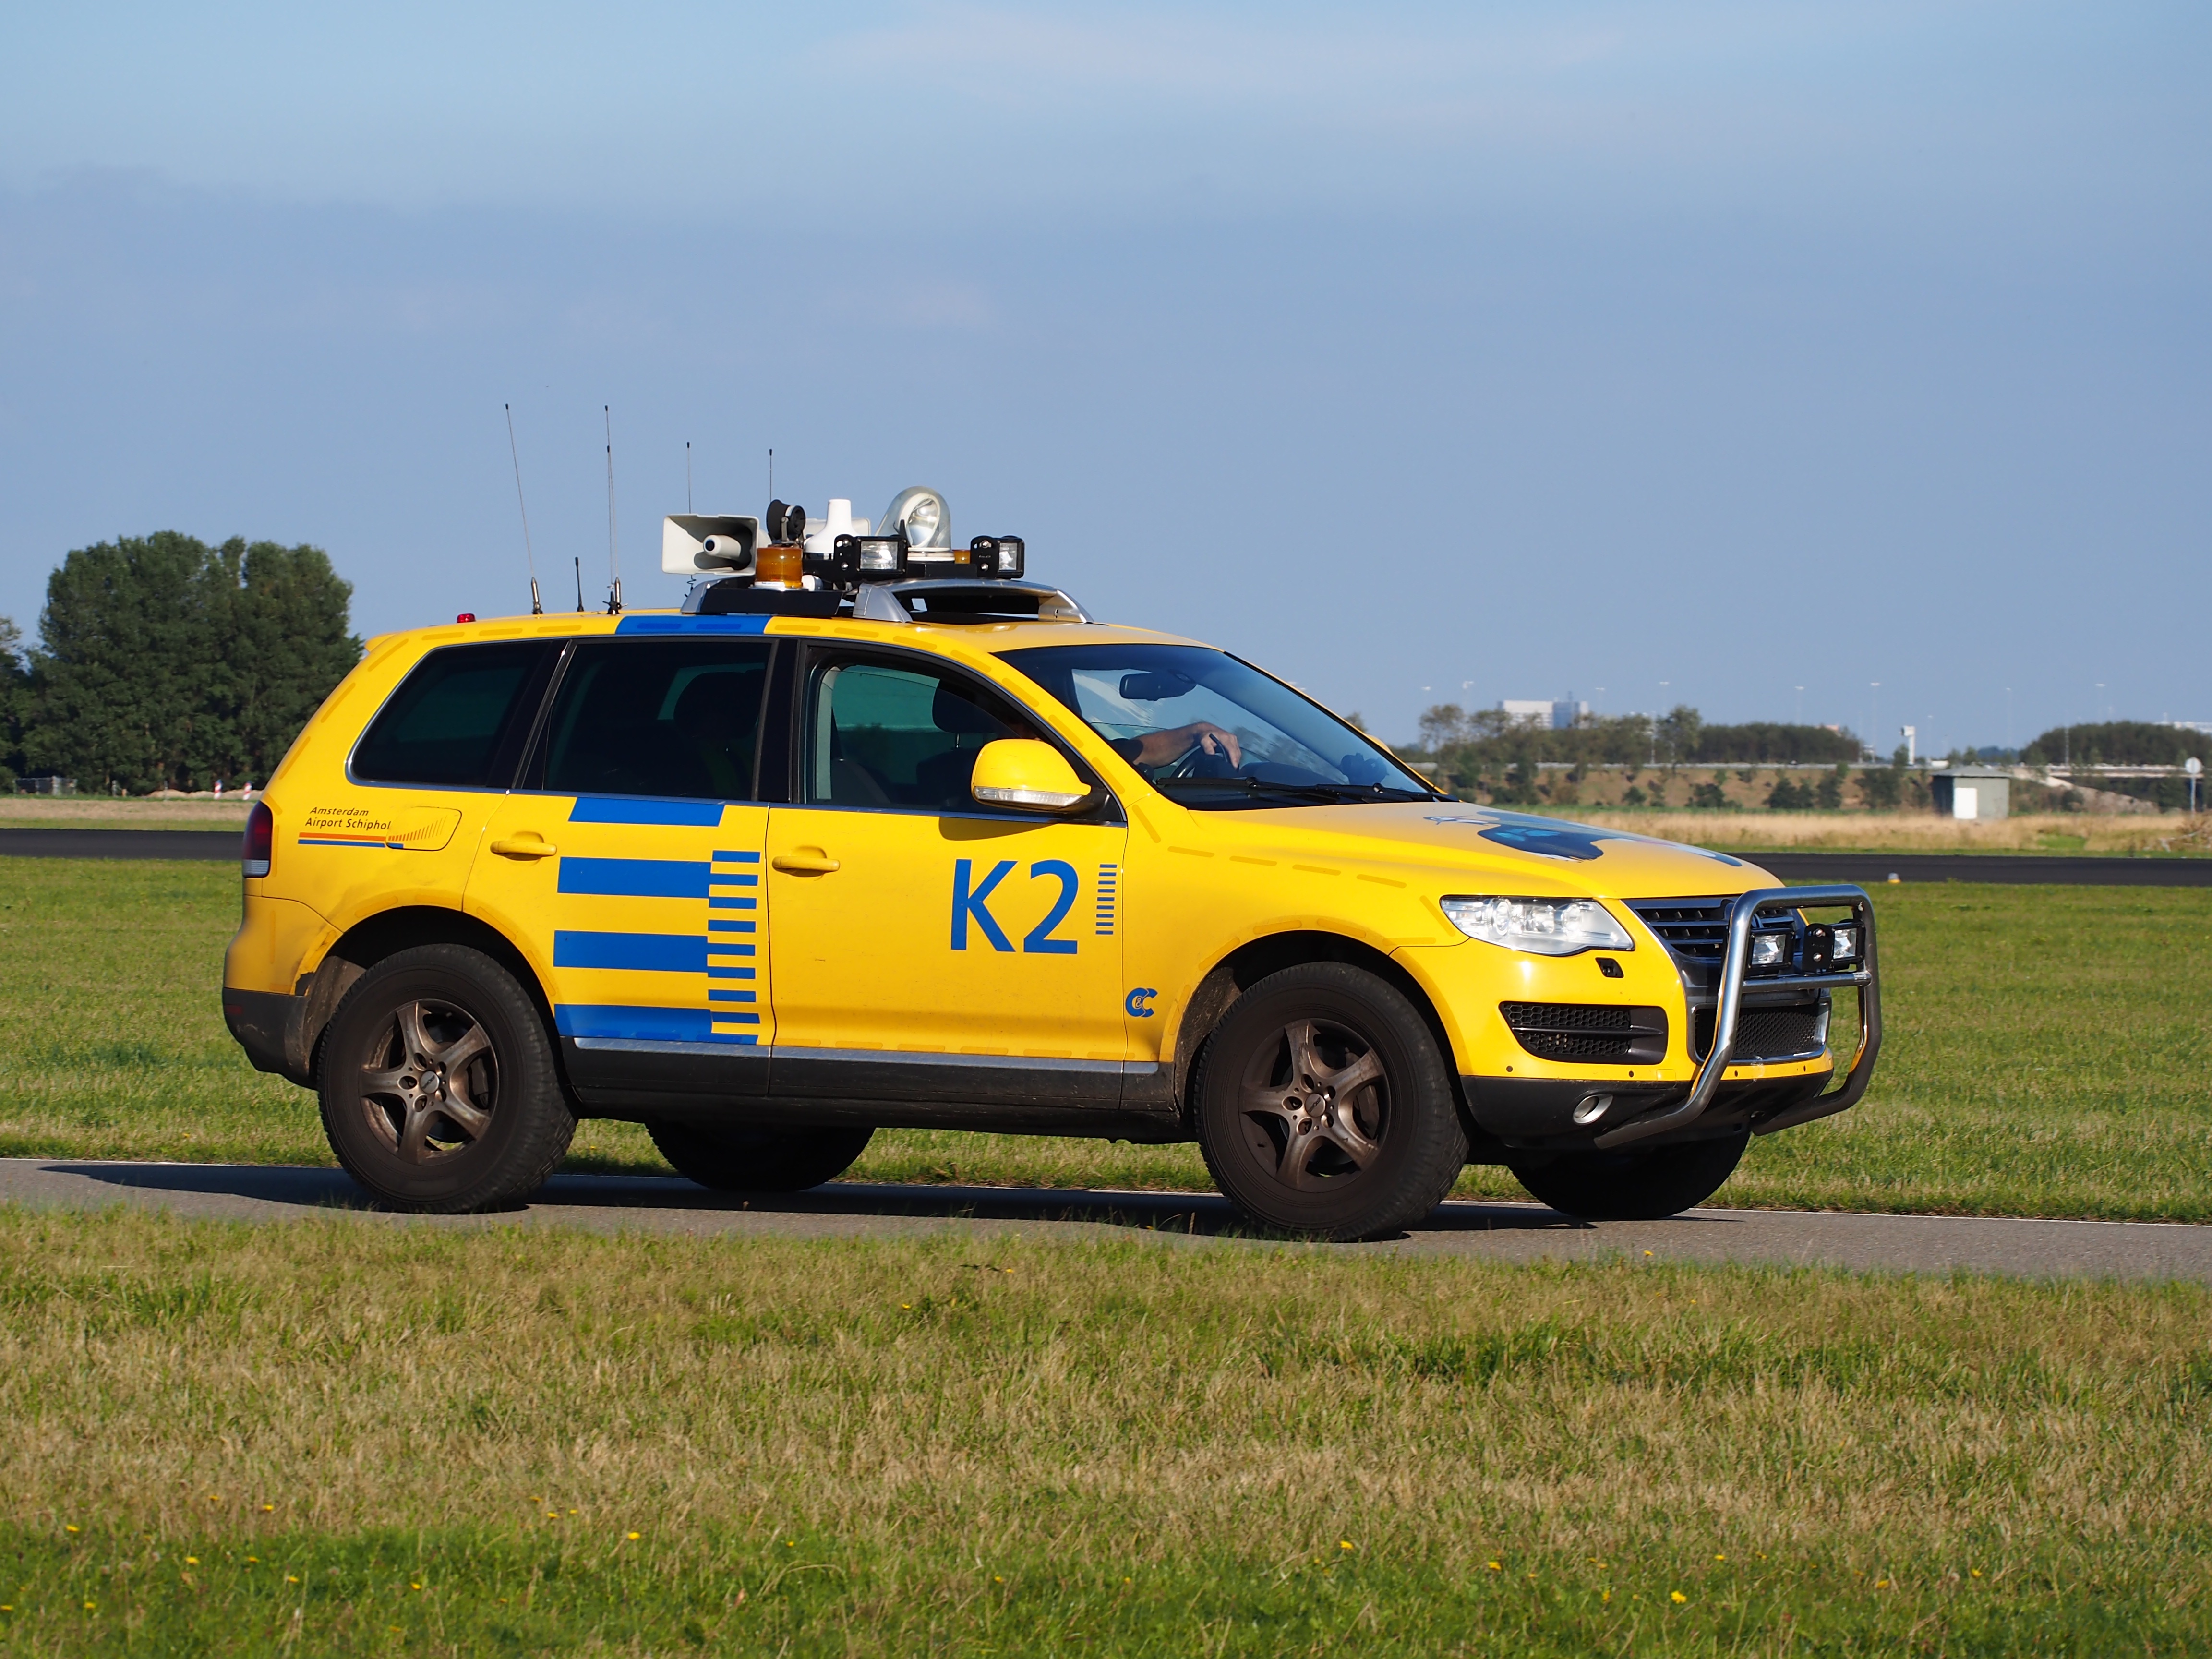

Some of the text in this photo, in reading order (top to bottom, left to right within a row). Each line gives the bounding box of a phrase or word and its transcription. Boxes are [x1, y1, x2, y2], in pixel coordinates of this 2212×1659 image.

[310, 807, 369, 816] Amsterdam
[305, 817, 391, 830] Airport Schiphol
[950, 859, 1079, 954] K2
